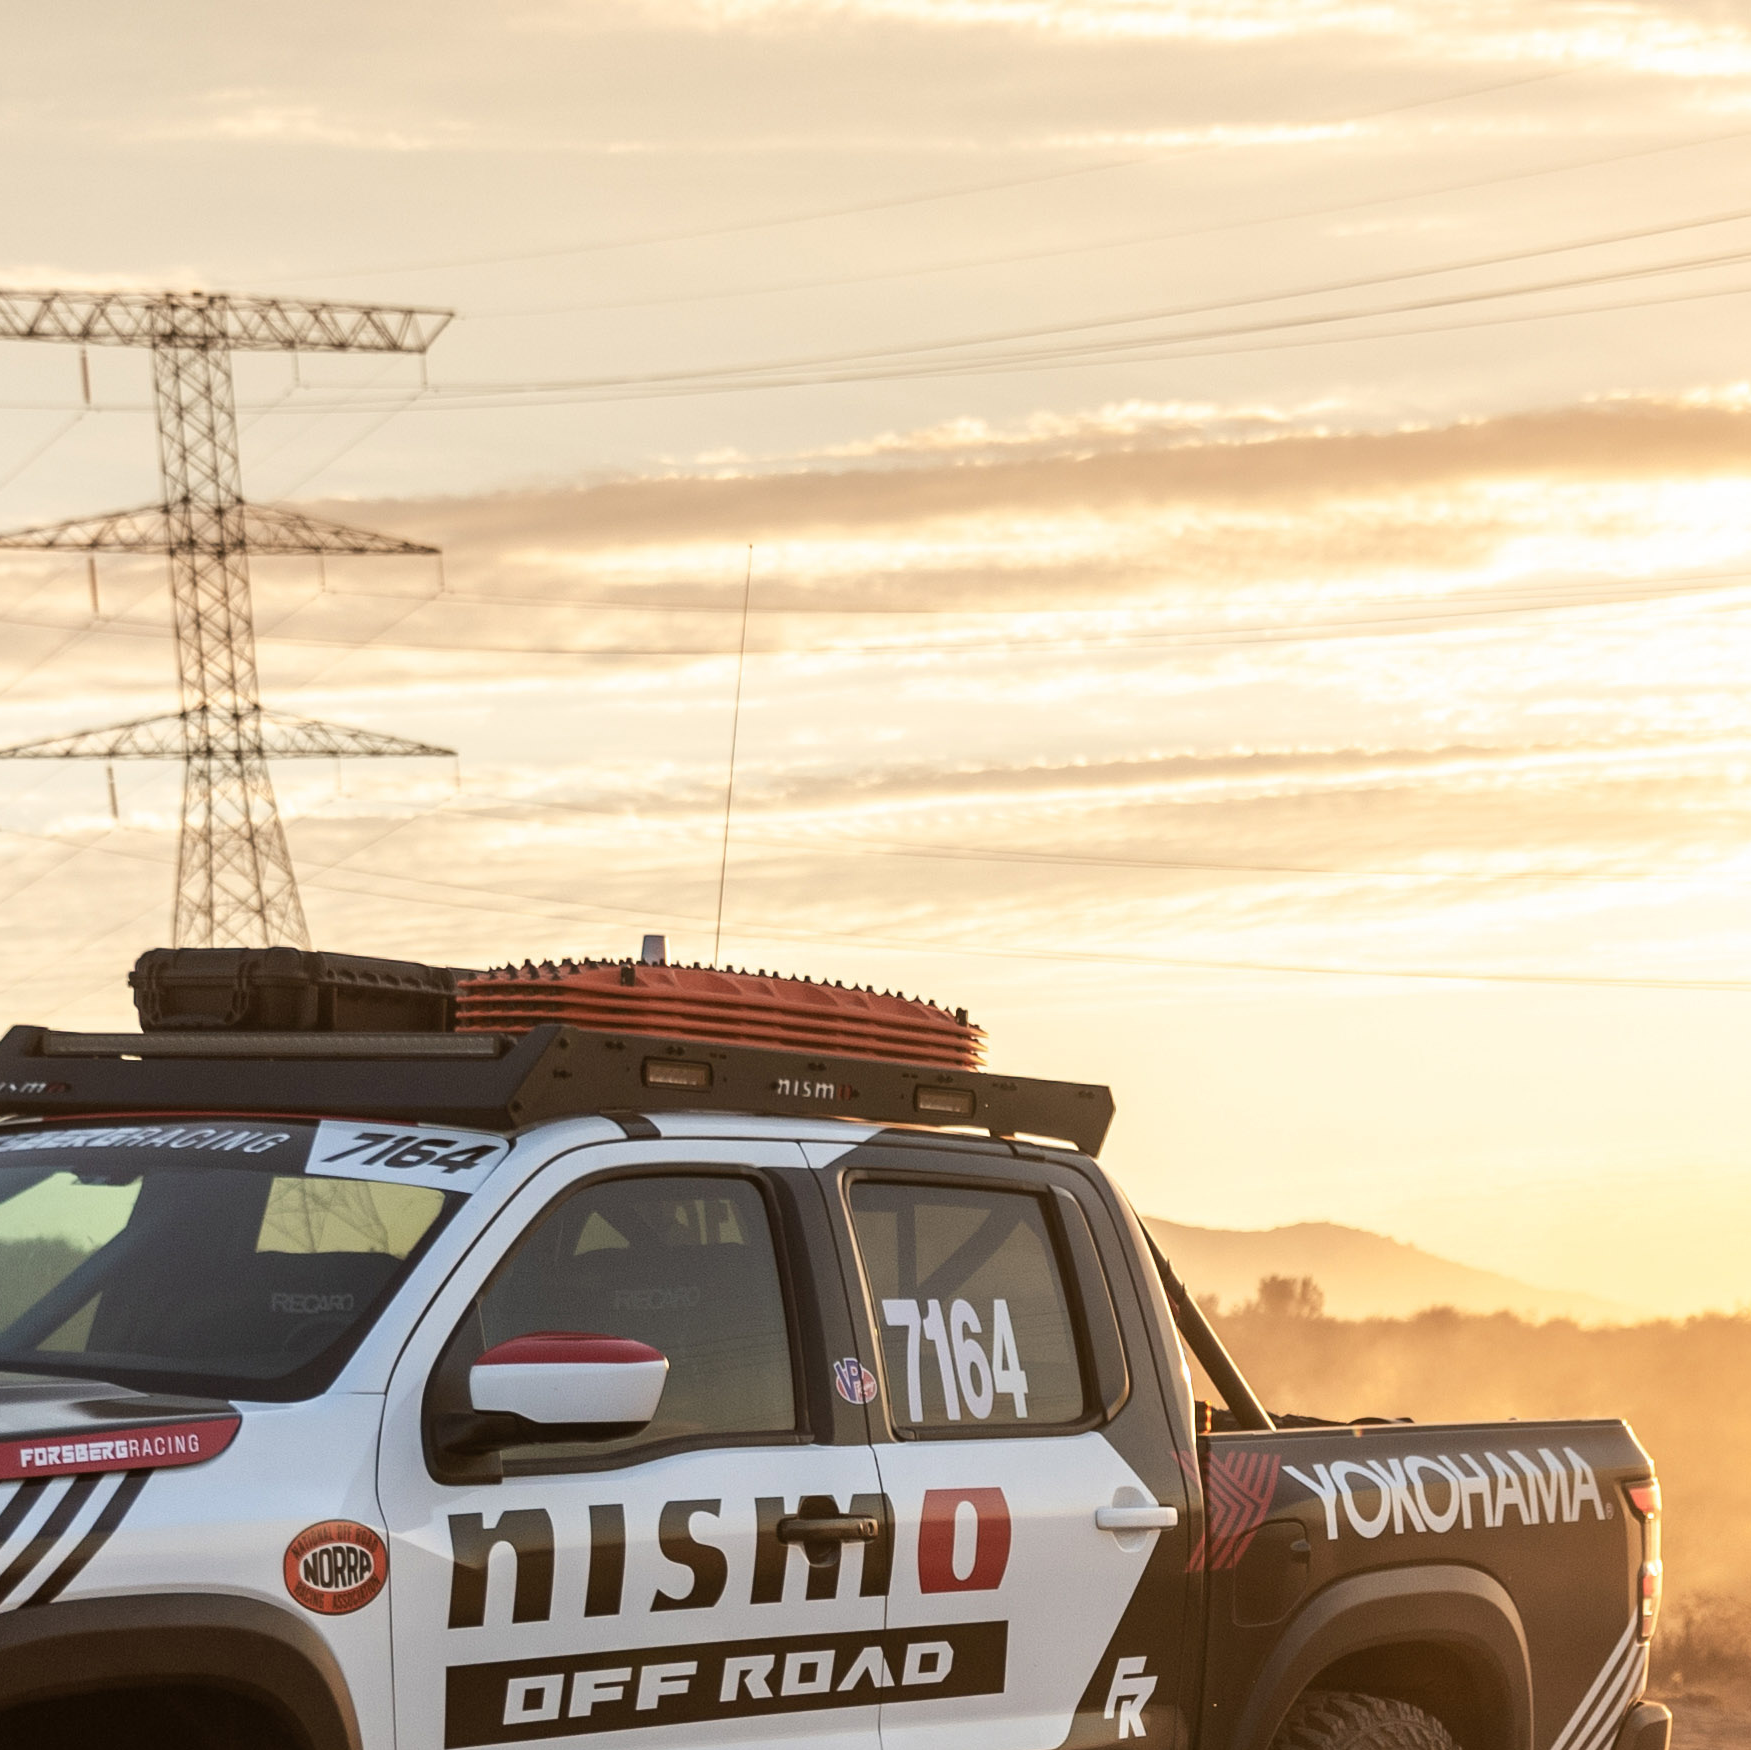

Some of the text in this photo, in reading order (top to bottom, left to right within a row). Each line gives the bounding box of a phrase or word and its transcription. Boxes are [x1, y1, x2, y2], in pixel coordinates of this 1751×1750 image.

[320, 1131, 500, 1175] 7164
[881, 1297, 1030, 1425] 7164
[1281, 1446, 1606, 1542] YOKOHAMA
[291, 1524, 380, 1559] NATIONAL OFF ROAD
[303, 1546, 372, 1588] NORRA
[447, 1487, 1012, 1629] nismo
[502, 1640, 954, 1726] OFF ROAD
